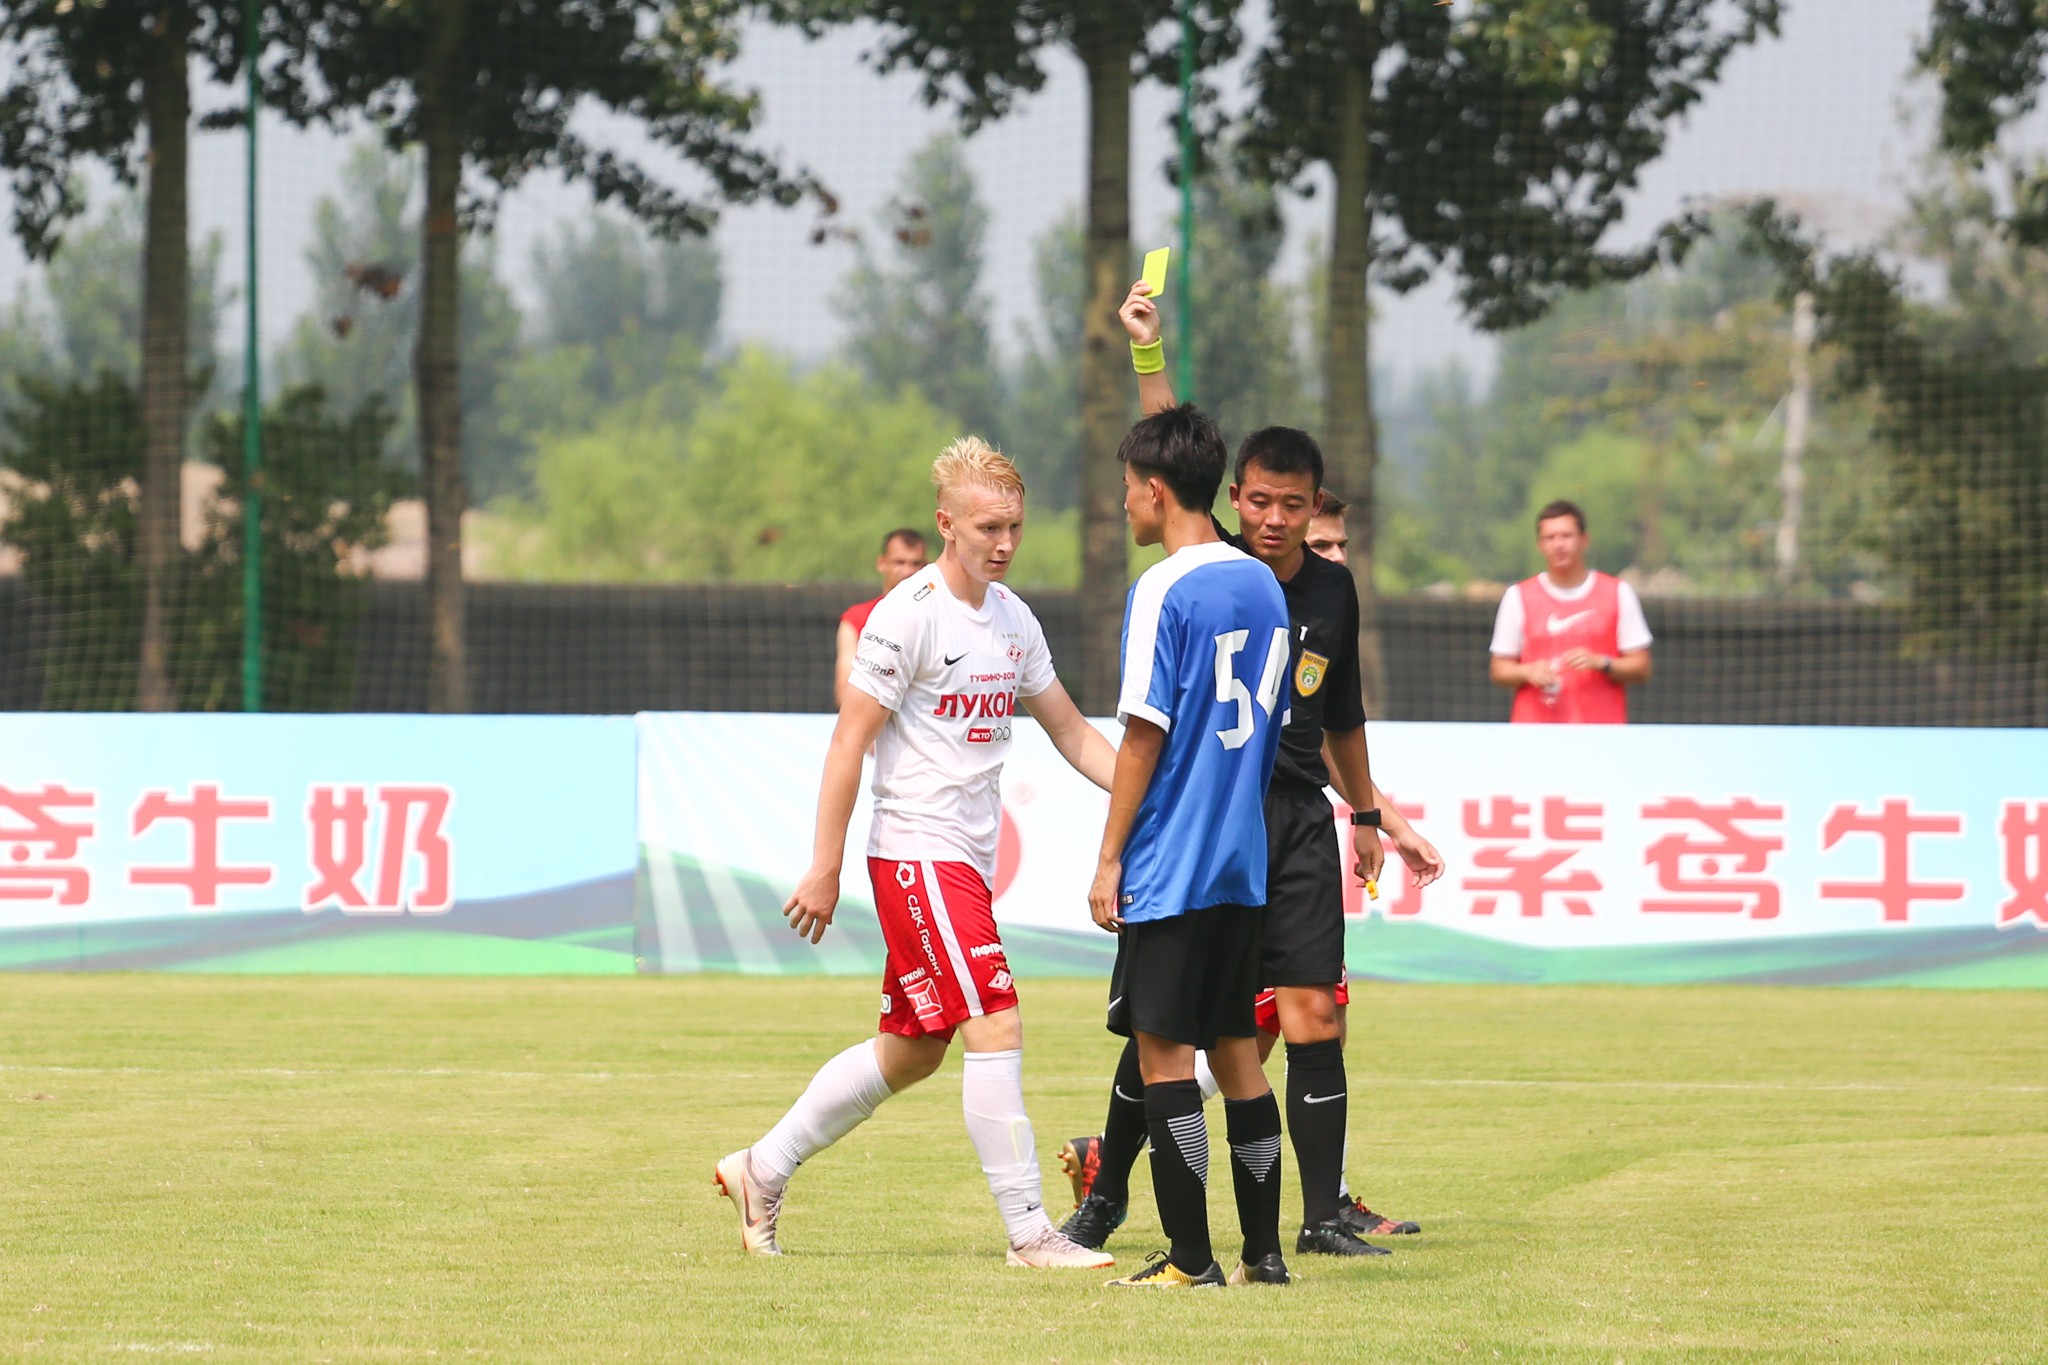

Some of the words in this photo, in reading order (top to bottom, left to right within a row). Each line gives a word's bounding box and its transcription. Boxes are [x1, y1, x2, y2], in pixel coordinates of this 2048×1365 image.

[864, 632, 902, 652] GENESIS
[1214, 627, 1290, 751] 54
[907, 894, 926, 929] СДК
[918, 928, 943, 977] Гарант
